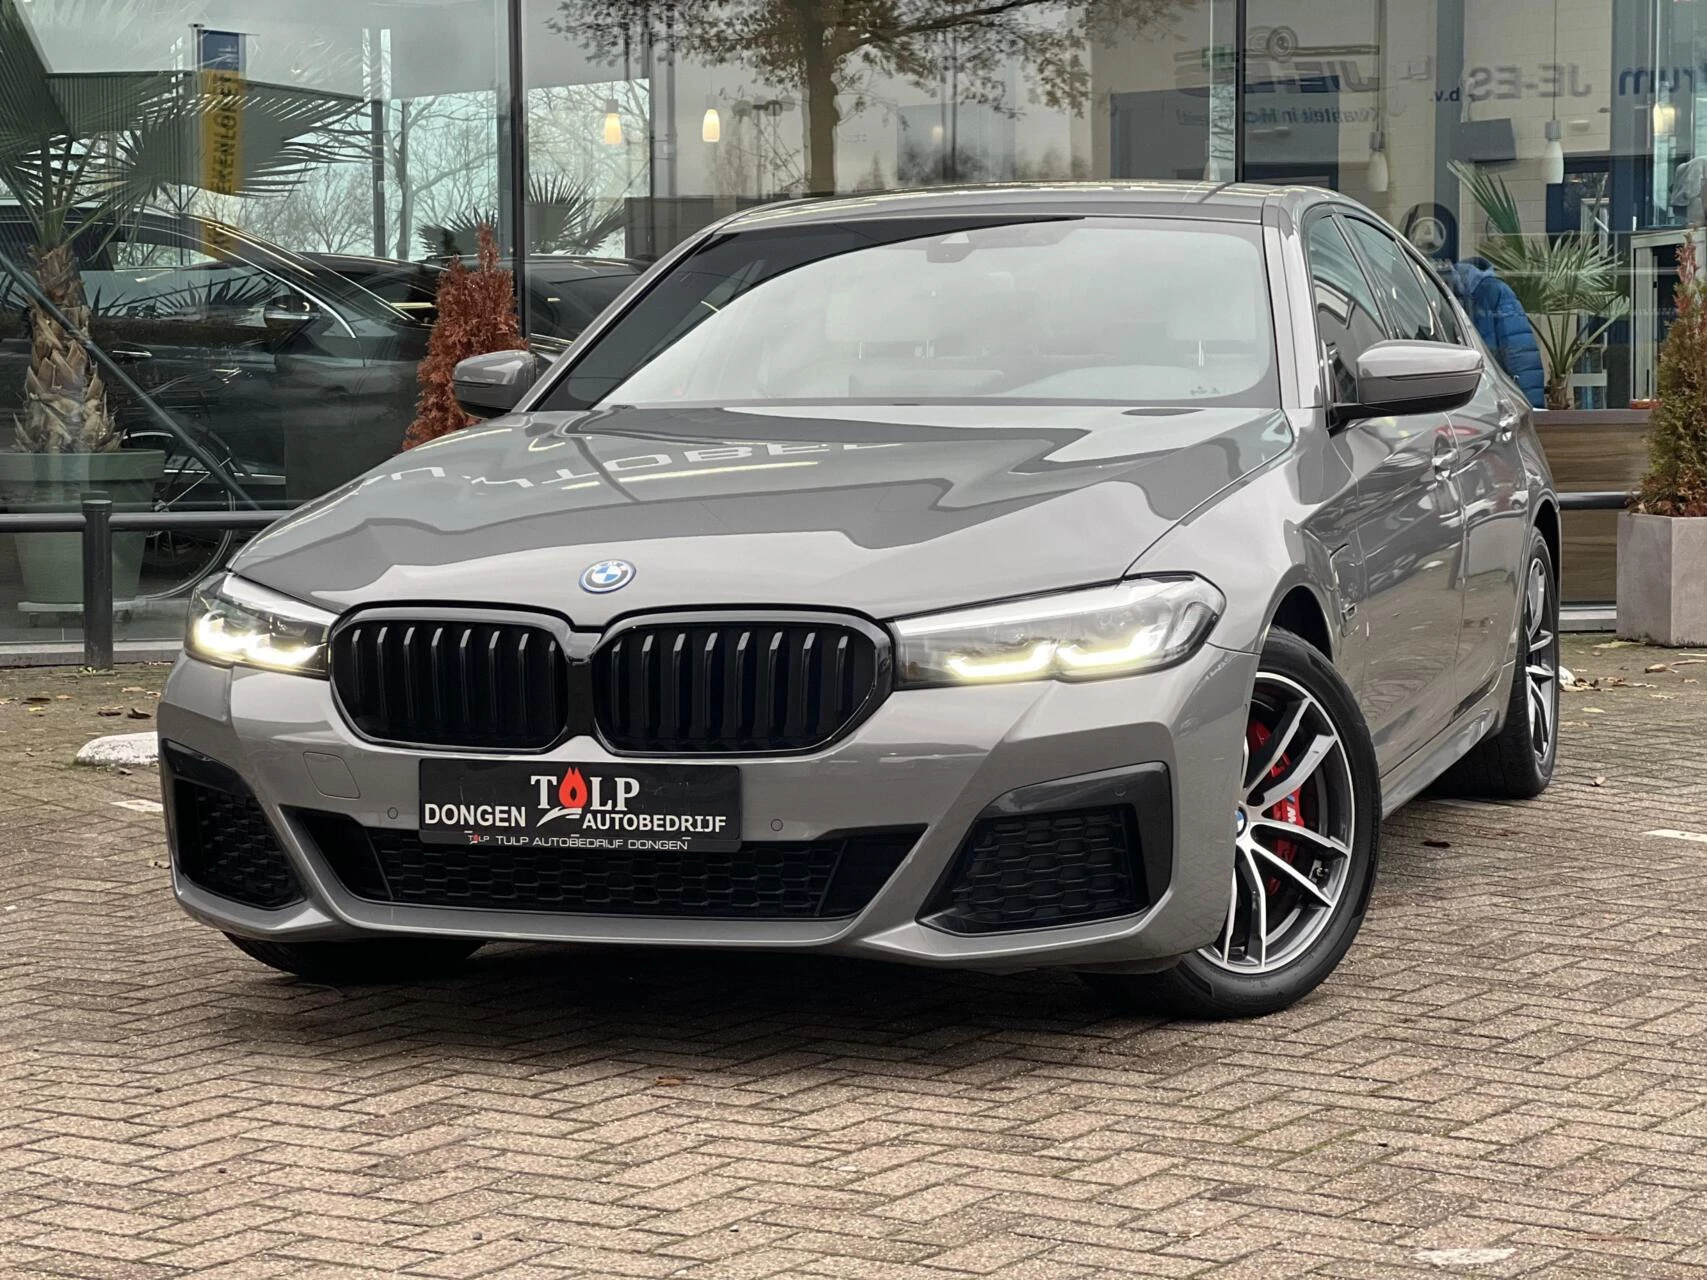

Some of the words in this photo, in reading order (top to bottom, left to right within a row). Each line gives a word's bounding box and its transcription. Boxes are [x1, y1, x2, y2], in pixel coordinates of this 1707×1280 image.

[424, 803, 526, 827] DONGEN
[582, 813, 727, 833] AUTOBEDRIJF
[495, 835, 529, 846] TULP
[532, 837, 624, 849] AUTOBEDRIJF
[627, 839, 688, 850] DONGEN
